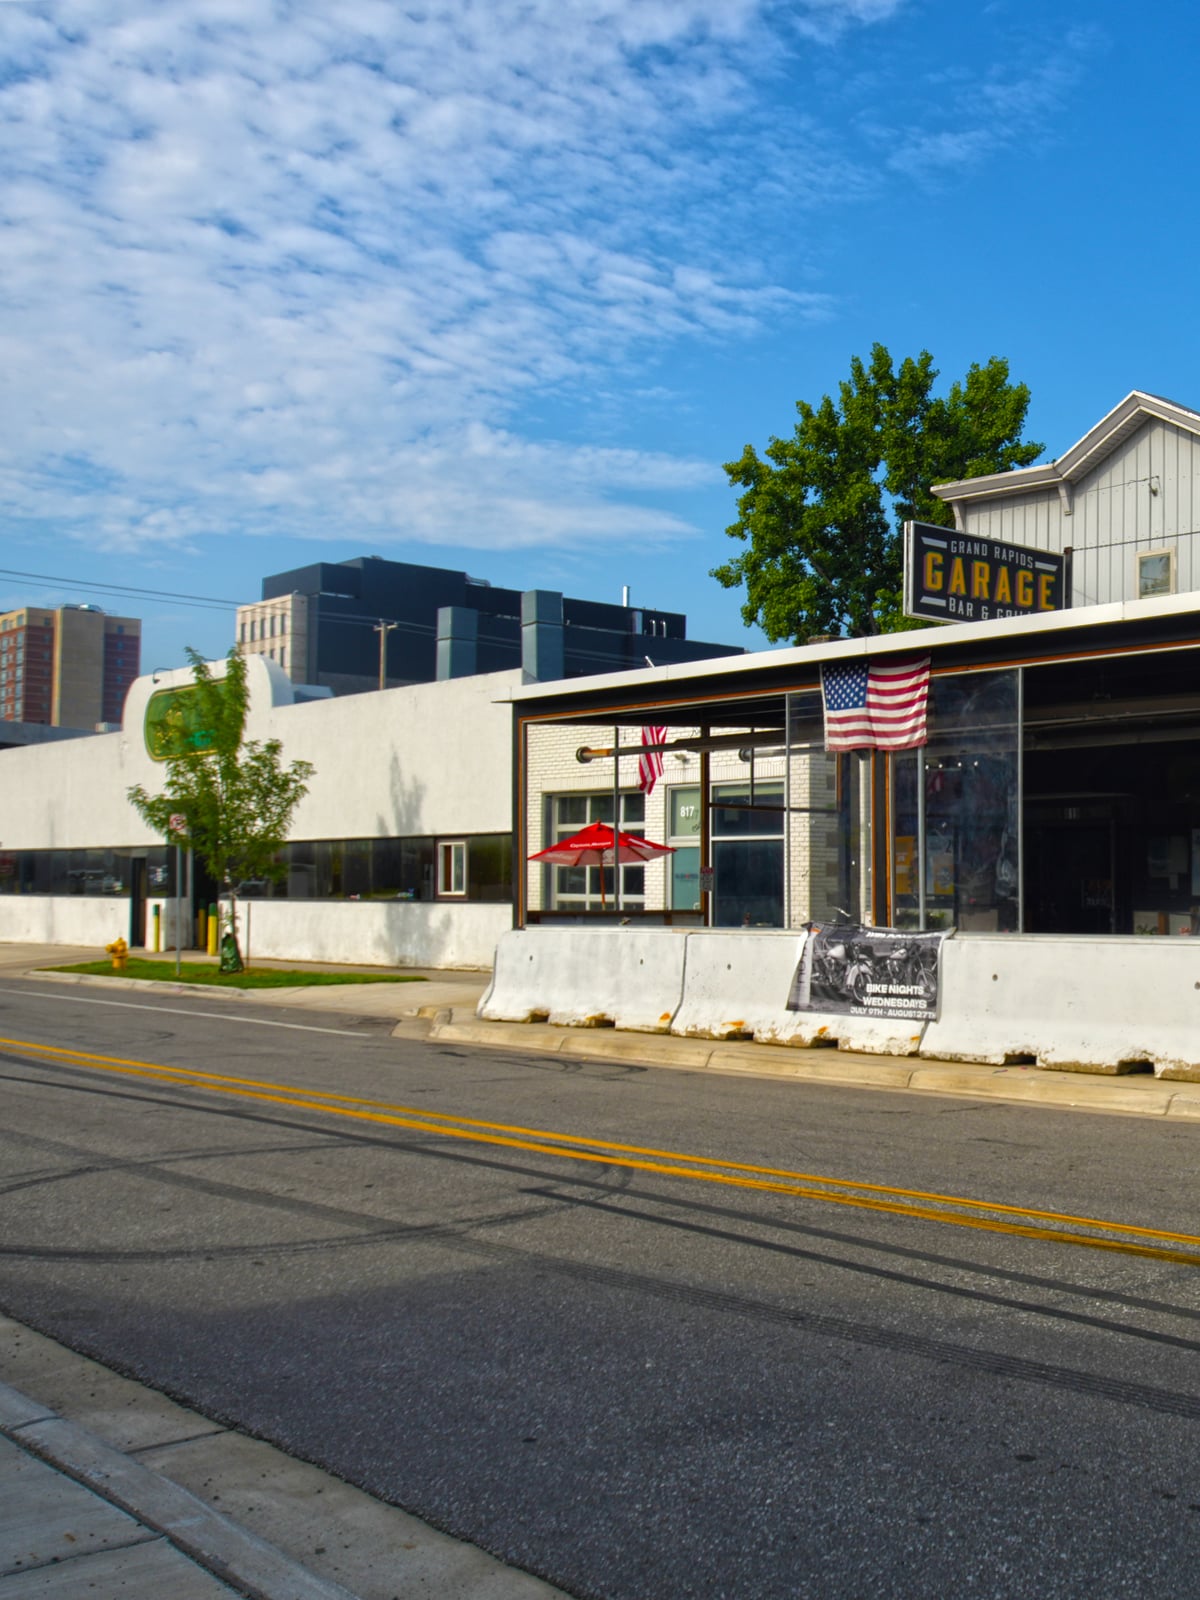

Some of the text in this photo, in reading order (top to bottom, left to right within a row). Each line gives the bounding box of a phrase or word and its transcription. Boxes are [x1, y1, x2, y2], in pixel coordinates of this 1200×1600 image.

[951, 540, 1034, 569] GRAND RAPIDS
[923, 551, 1056, 611] GARAGE
[949, 597, 974, 617] BAR
[981, 605, 989, 620] &
[680, 806, 694, 817] 817
[866, 983, 924, 995] BIKE NIGHTS
[862, 996, 927, 1009] WEDNESDAYS
[850, 1006, 867, 1014] JULY
[887, 1009, 916, 1017] AUGUST
